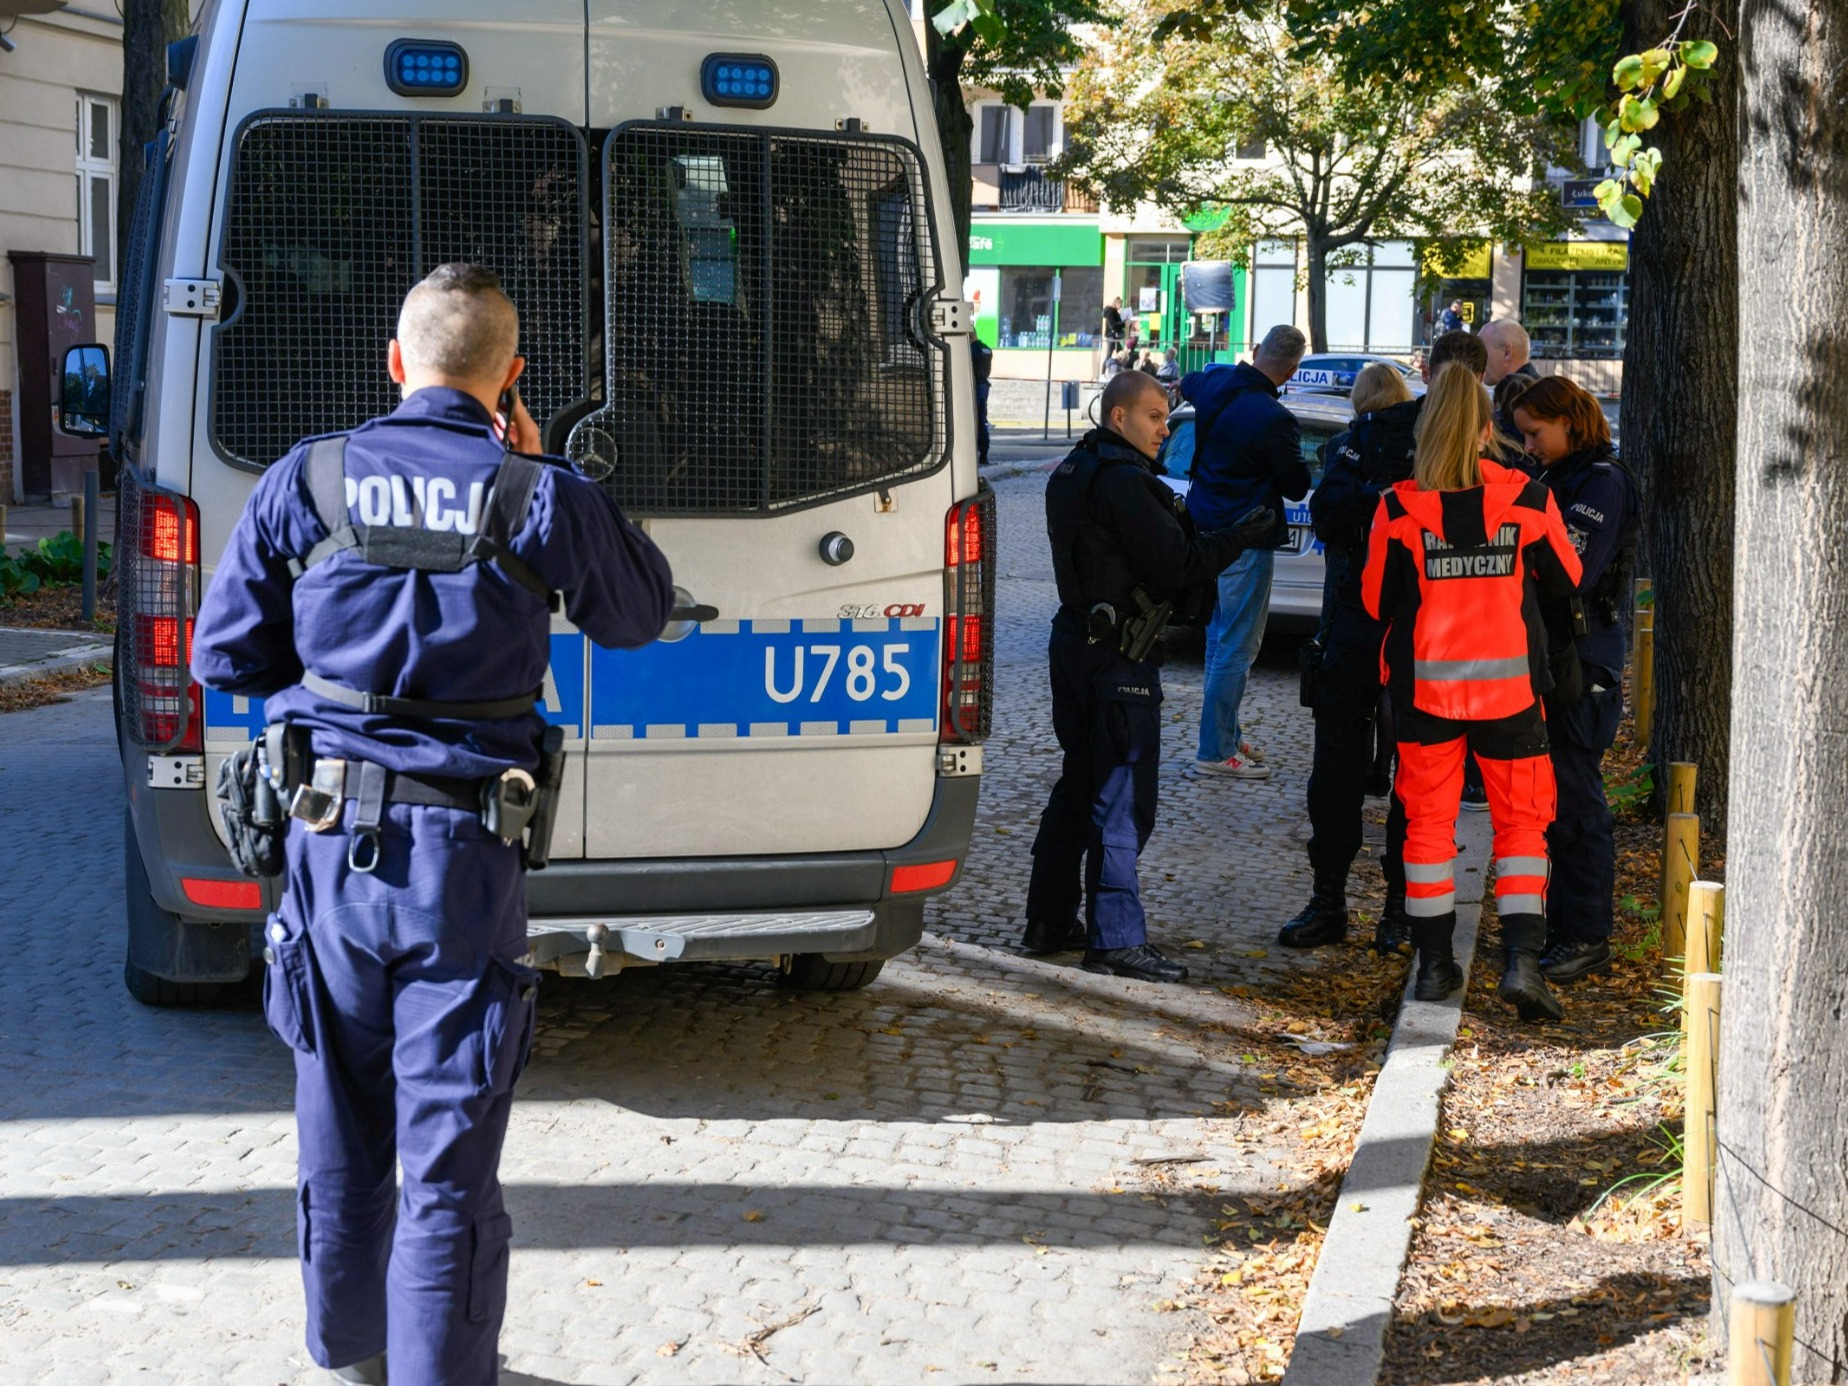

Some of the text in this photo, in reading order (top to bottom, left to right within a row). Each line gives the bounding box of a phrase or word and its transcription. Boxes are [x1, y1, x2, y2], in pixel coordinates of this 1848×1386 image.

[1290, 370, 1328, 385] LICJA
[344, 475, 495, 535] POLICJ
[1570, 502, 1604, 524] POLICJA
[1426, 554, 1514, 579] MEDYCZNY
[883, 603, 926, 618] CDI
[765, 643, 911, 704] U785
